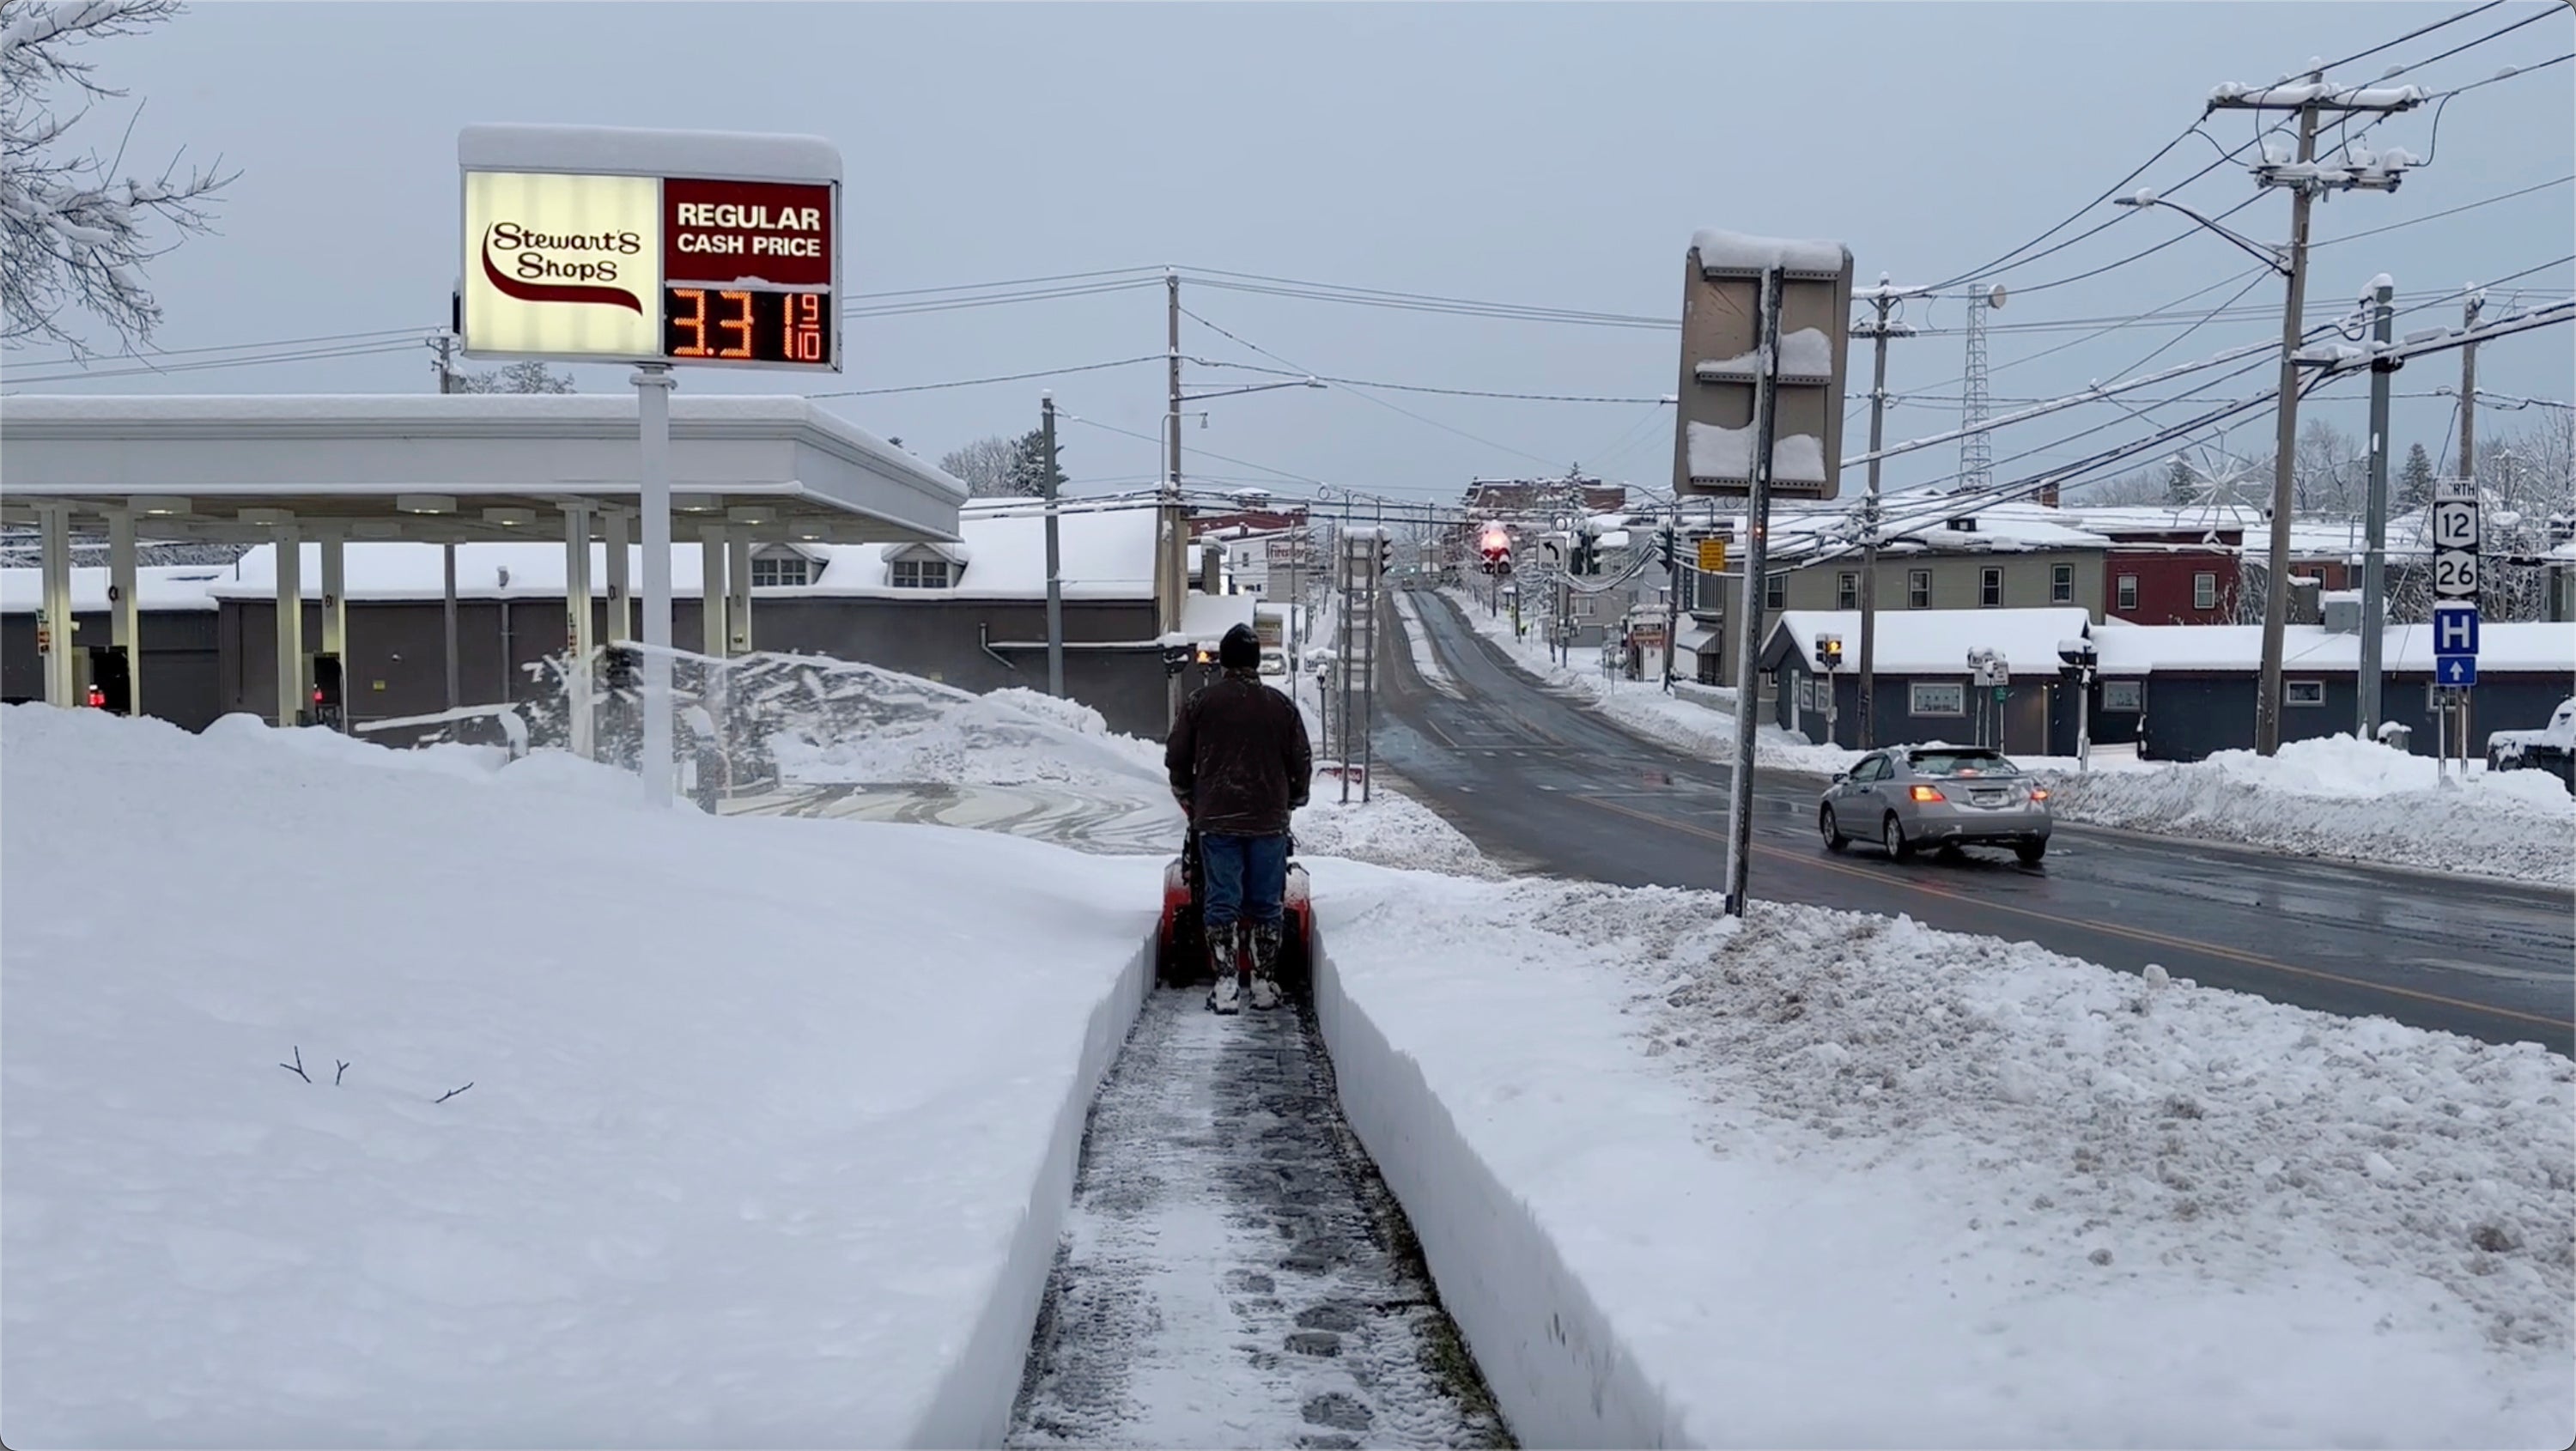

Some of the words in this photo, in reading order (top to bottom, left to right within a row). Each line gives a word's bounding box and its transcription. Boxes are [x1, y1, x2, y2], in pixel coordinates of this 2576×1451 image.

[677, 203, 821, 231] REGULAR
[493, 222, 641, 255] Stewart's
[677, 233, 744, 254] CASH
[752, 236, 821, 257] PRICE
[517, 252, 617, 282] Shops
[673, 288, 793, 359] 3.31
[2438, 483, 2475, 495] RTH
[2444, 513, 2470, 537] 12
[2439, 561, 2474, 585] 26
[2442, 615, 2470, 648] H
